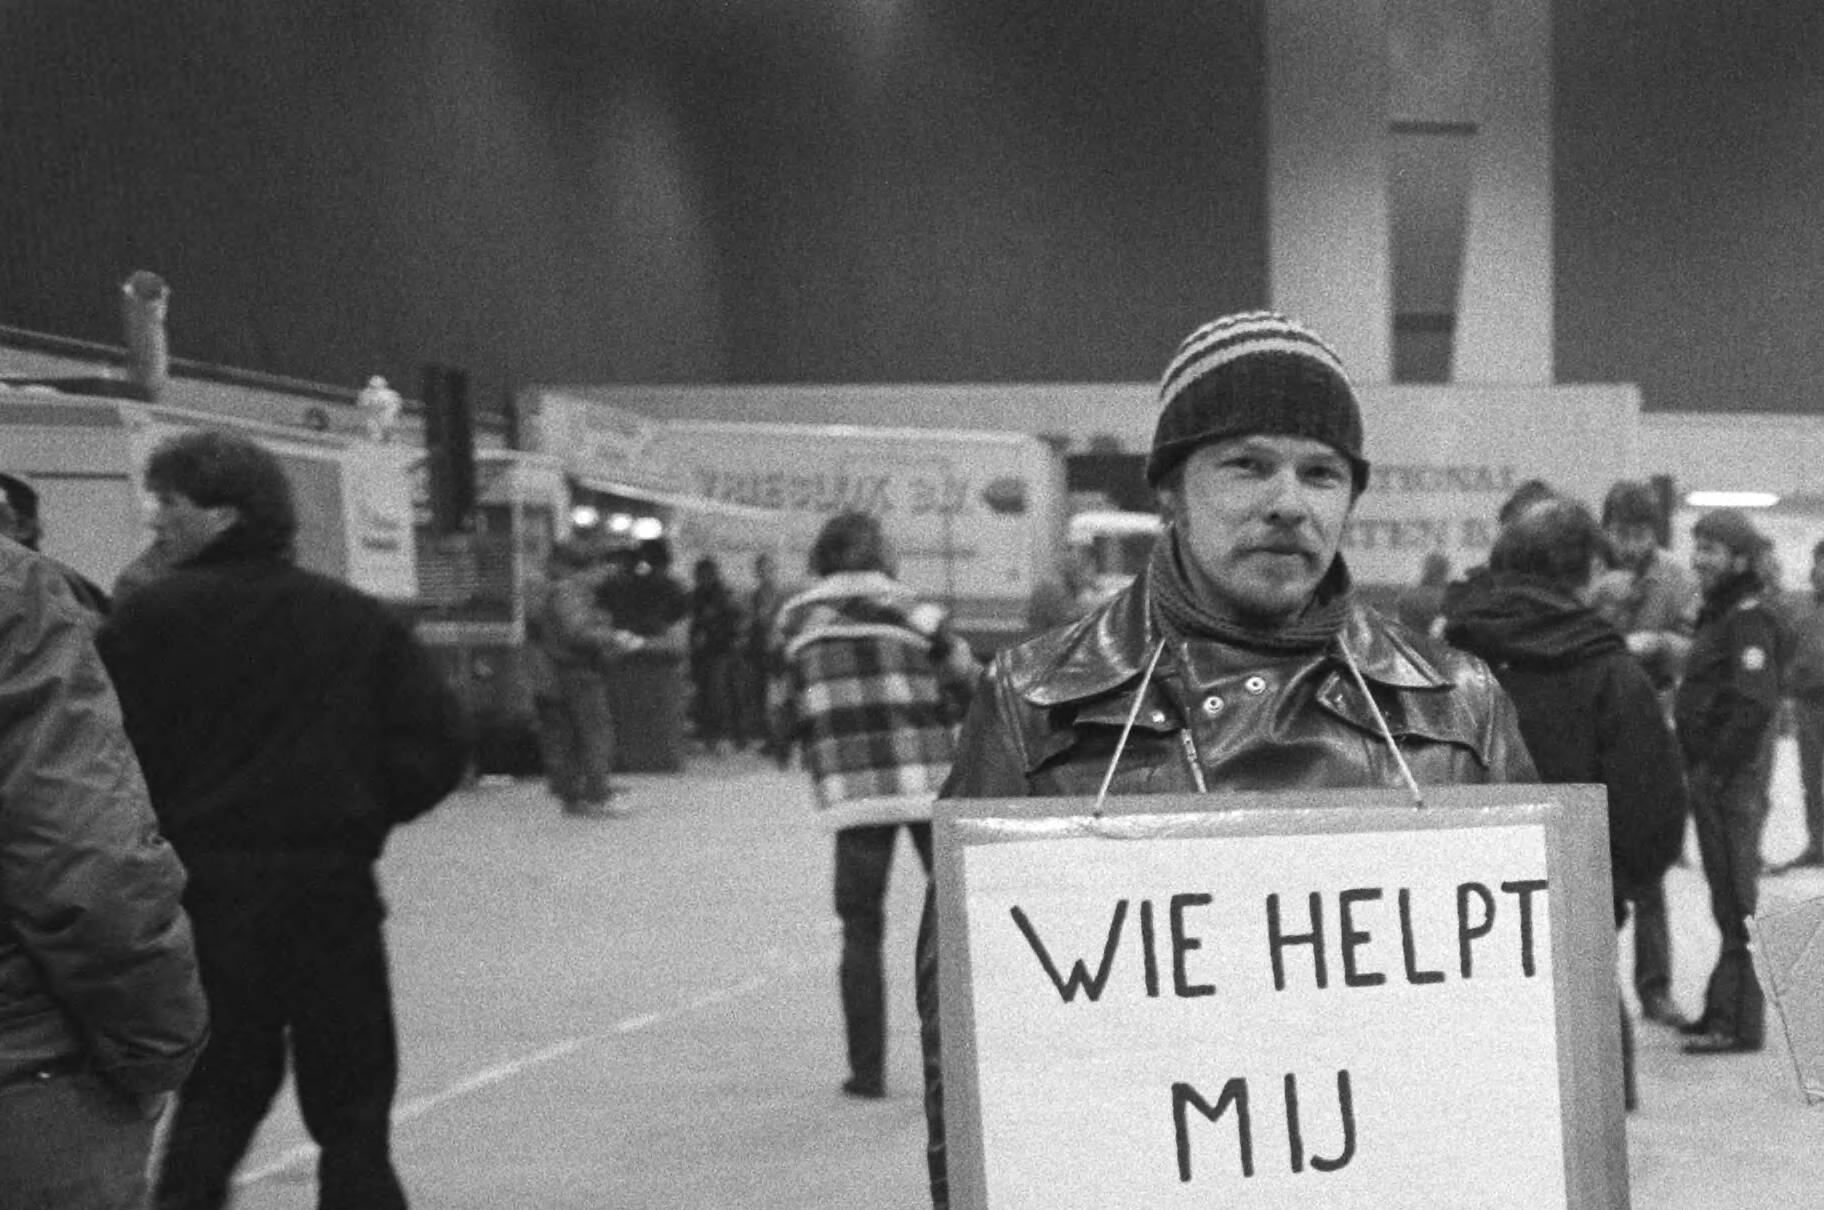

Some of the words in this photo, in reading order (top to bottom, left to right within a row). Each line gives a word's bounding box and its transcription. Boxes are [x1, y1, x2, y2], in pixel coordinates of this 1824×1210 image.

[1009, 892, 1216, 1003] WIE
[1265, 878, 1549, 992] HELPT
[1171, 1068, 1357, 1183] MIJ
